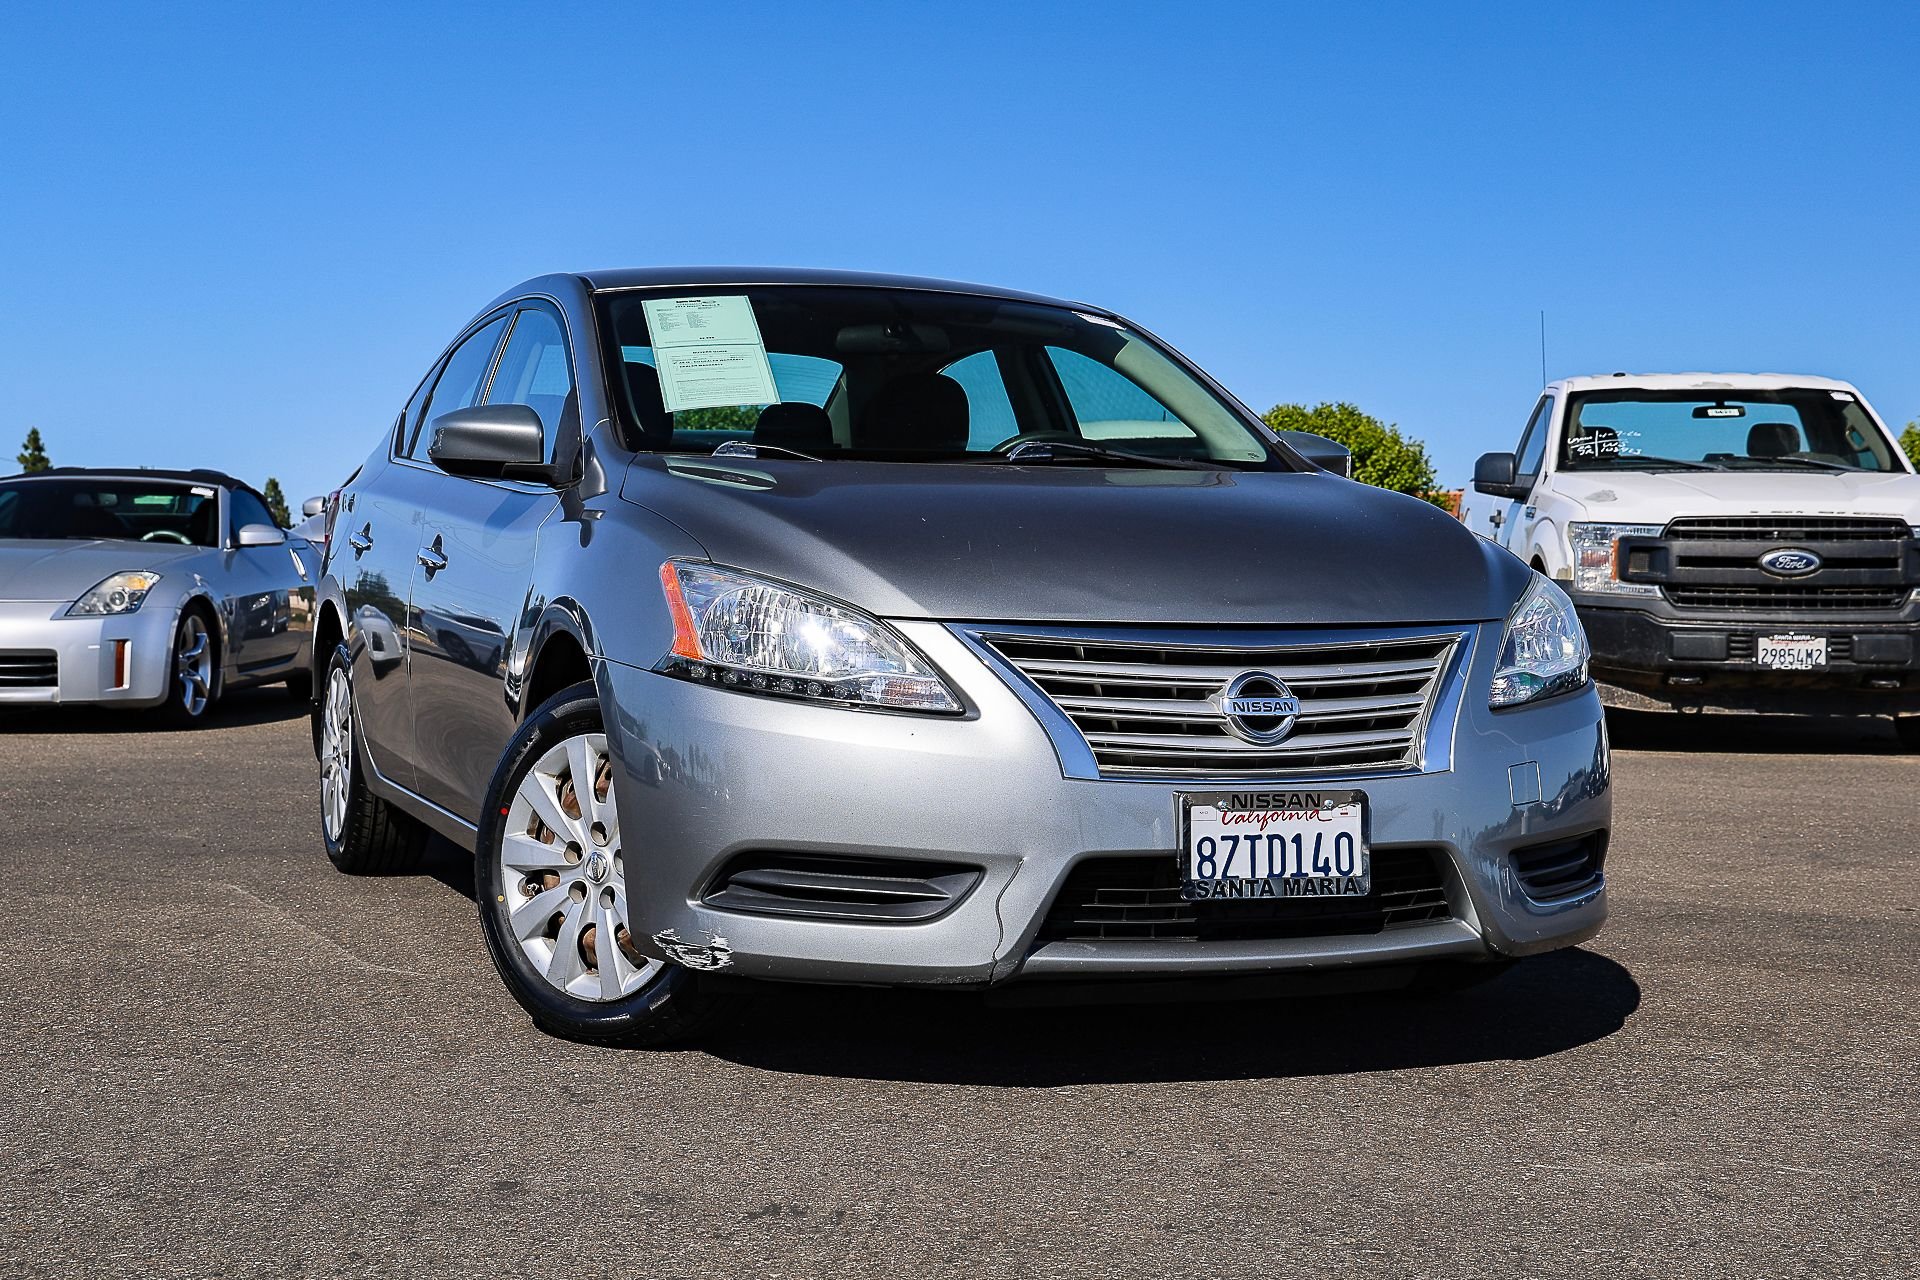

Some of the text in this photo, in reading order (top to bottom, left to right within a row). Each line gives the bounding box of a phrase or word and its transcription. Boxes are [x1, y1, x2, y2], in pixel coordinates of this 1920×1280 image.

[1776, 555, 1806, 568] Ford
[1232, 701, 1294, 713] NISSAN
[1231, 793, 1321, 809] NISSAN
[1221, 809, 1333, 832] California
[1196, 831, 1355, 880] 8ZTD140
[1196, 878, 1359, 899] SANTA MARIA
